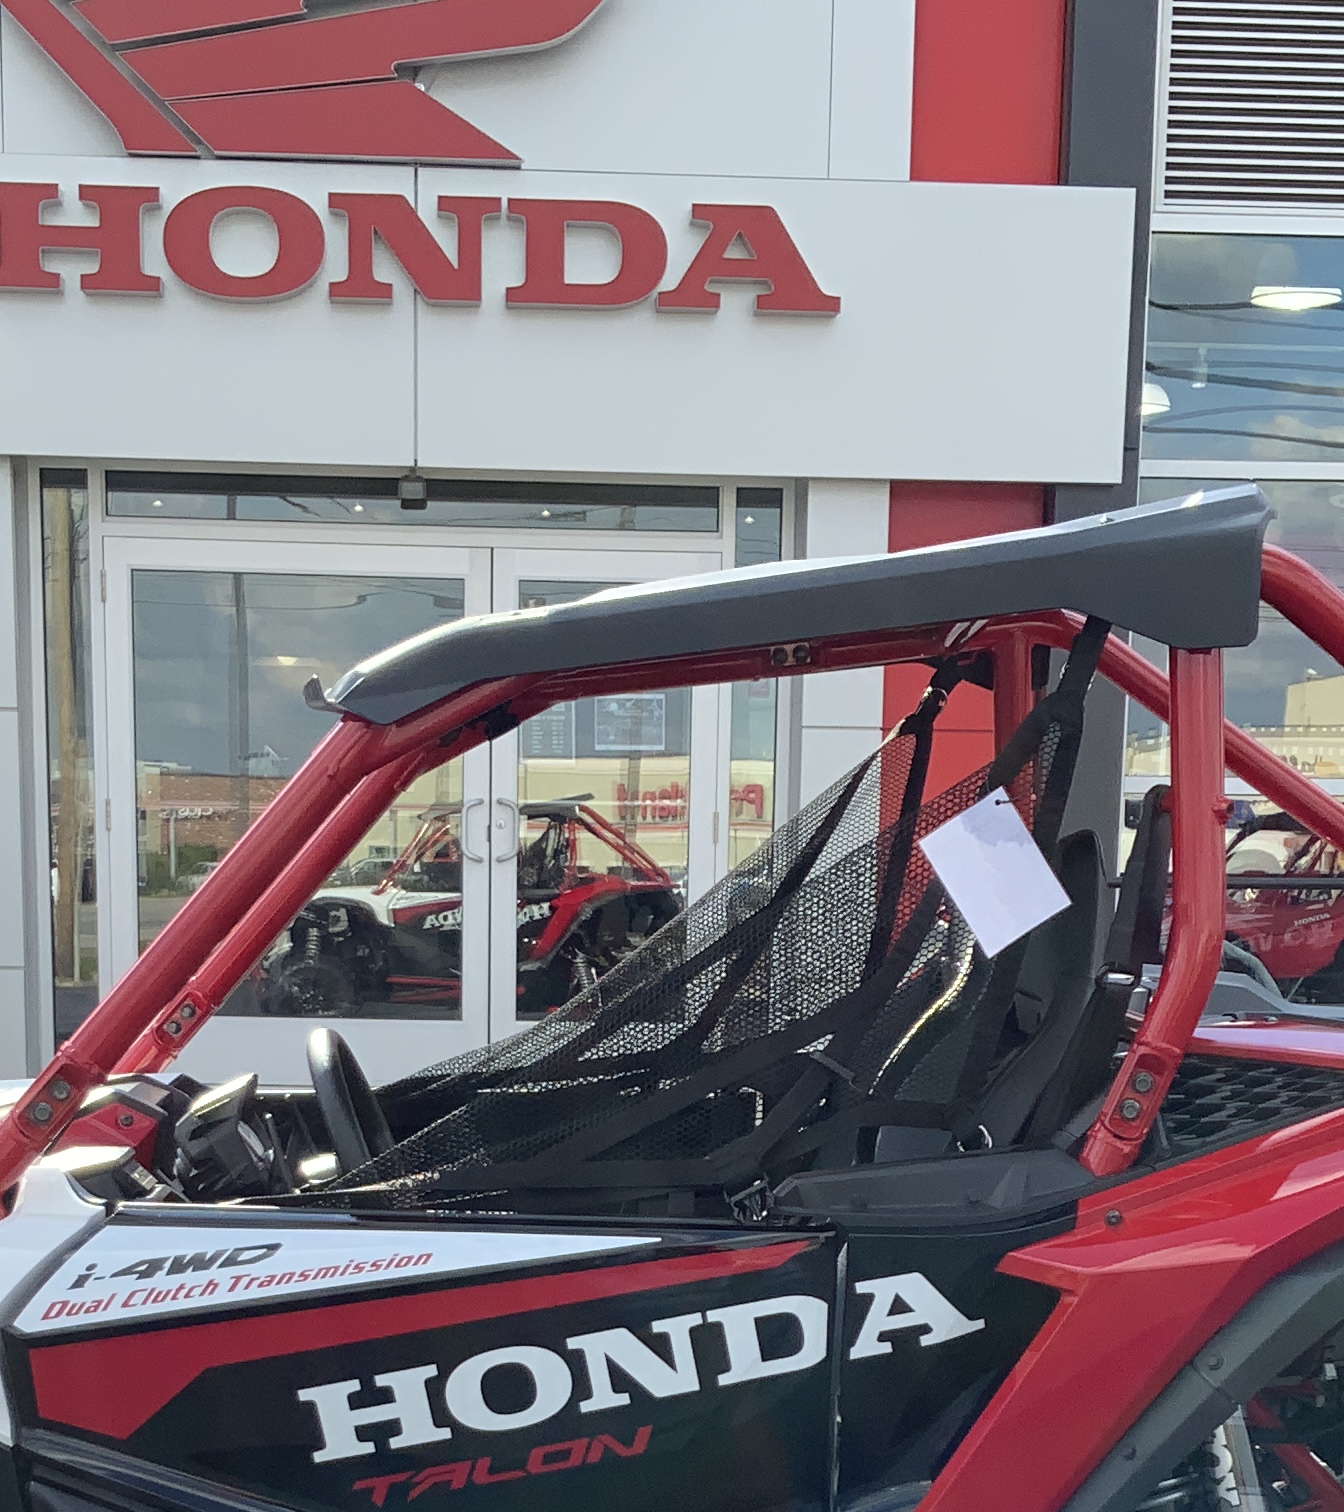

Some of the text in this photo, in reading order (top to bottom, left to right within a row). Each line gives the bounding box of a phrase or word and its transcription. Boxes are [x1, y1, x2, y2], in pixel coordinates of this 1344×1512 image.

[1294, 912, 1331, 927] HONDA
[40, 1252, 435, 1322] Dual Clutch Transmission
[67, 1242, 284, 1290] i-4WD
[297, 1271, 986, 1463] HONDA
[352, 1425, 654, 1508] TALON
